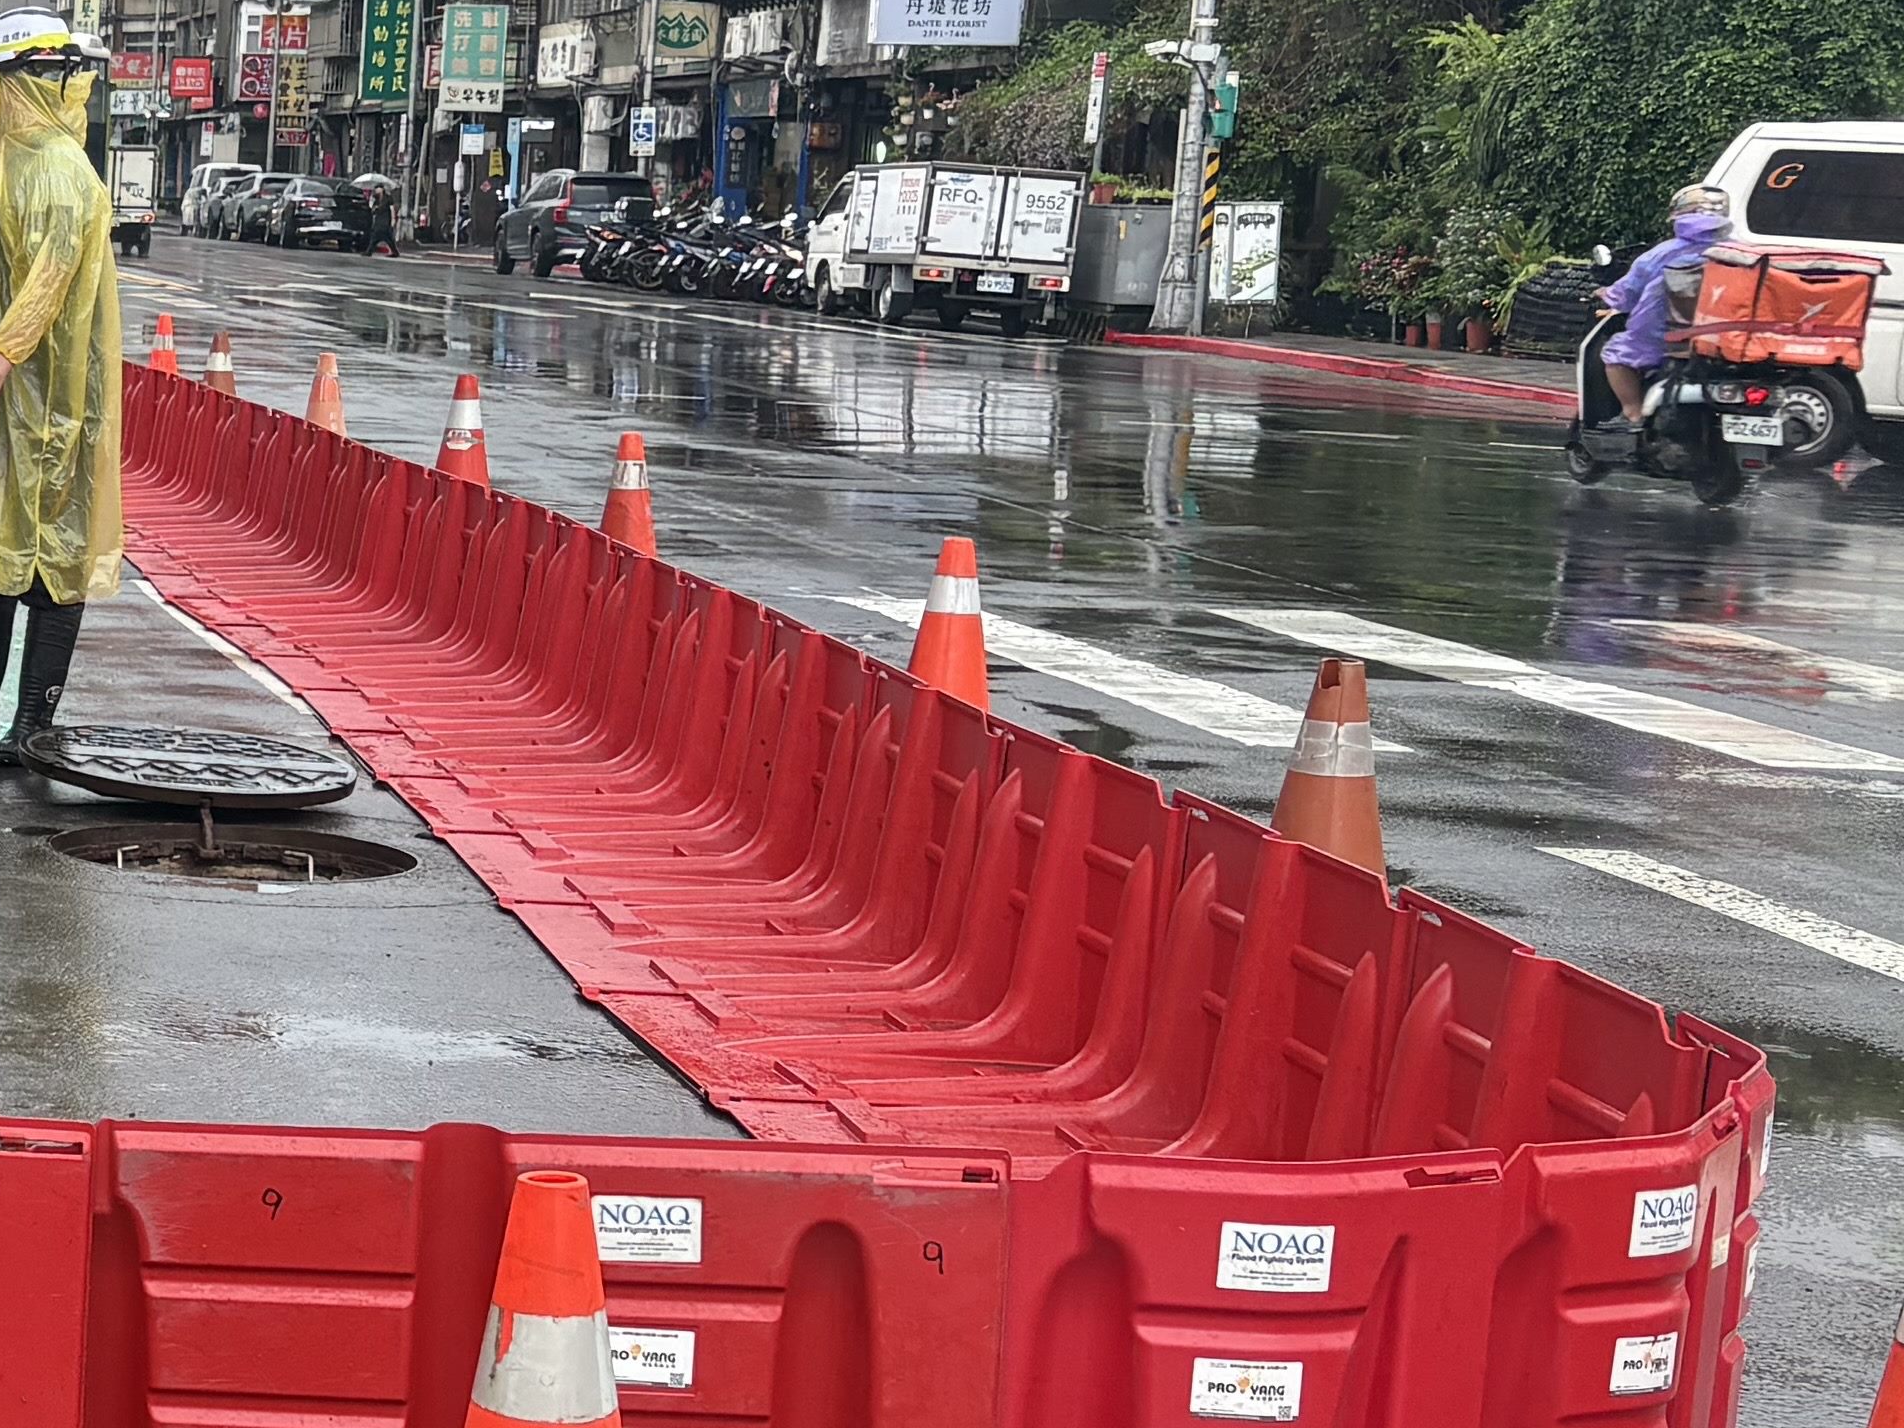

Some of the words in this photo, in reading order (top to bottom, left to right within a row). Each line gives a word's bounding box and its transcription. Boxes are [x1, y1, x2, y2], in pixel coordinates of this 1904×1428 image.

[908, 19, 942, 28] DANTE
[946, 19, 988, 28] FLORIST
[1767, 163, 1805, 189] G
[599, 1203, 692, 1226] NOAQ
[1232, 1231, 1325, 1255] NOAQ
